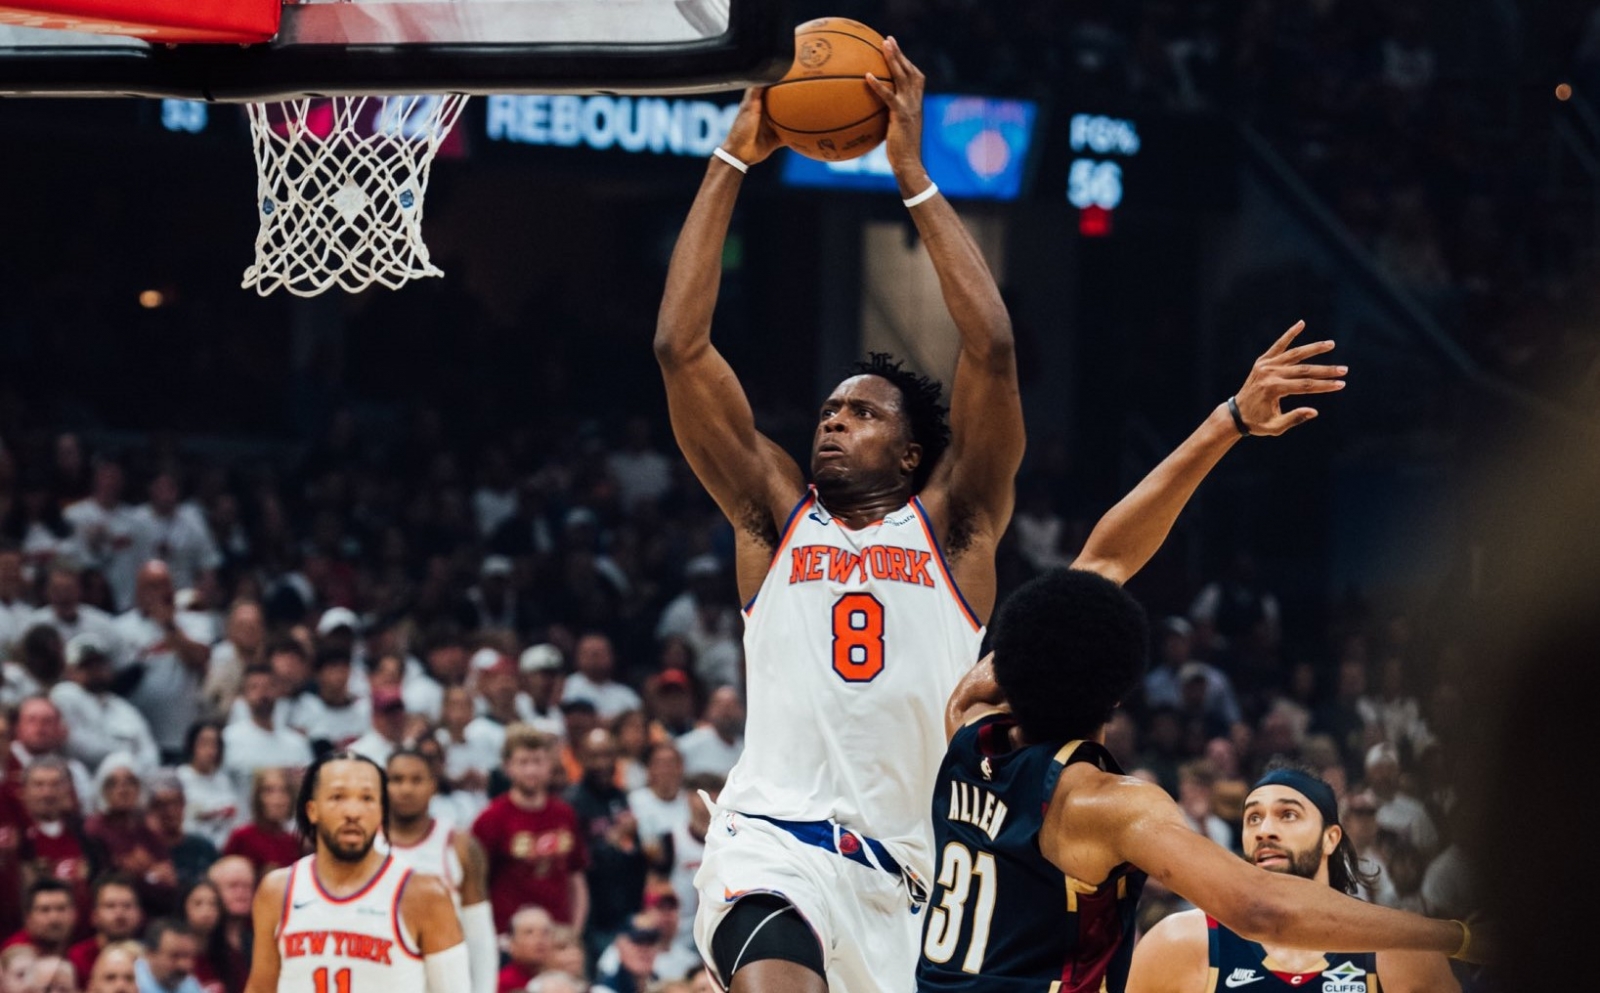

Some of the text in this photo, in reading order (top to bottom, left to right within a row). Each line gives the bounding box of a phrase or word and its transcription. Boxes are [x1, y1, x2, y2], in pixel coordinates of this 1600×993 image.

[789, 545, 935, 588] NEW YORK
[832, 591, 885, 683] 8
[948, 780, 1008, 842] ALLEN
[924, 841, 997, 975] 31
[284, 930, 393, 966] NEW YORK
[1232, 967, 1256, 981] NIKE
[1324, 984, 1365, 993] CLIFFS
